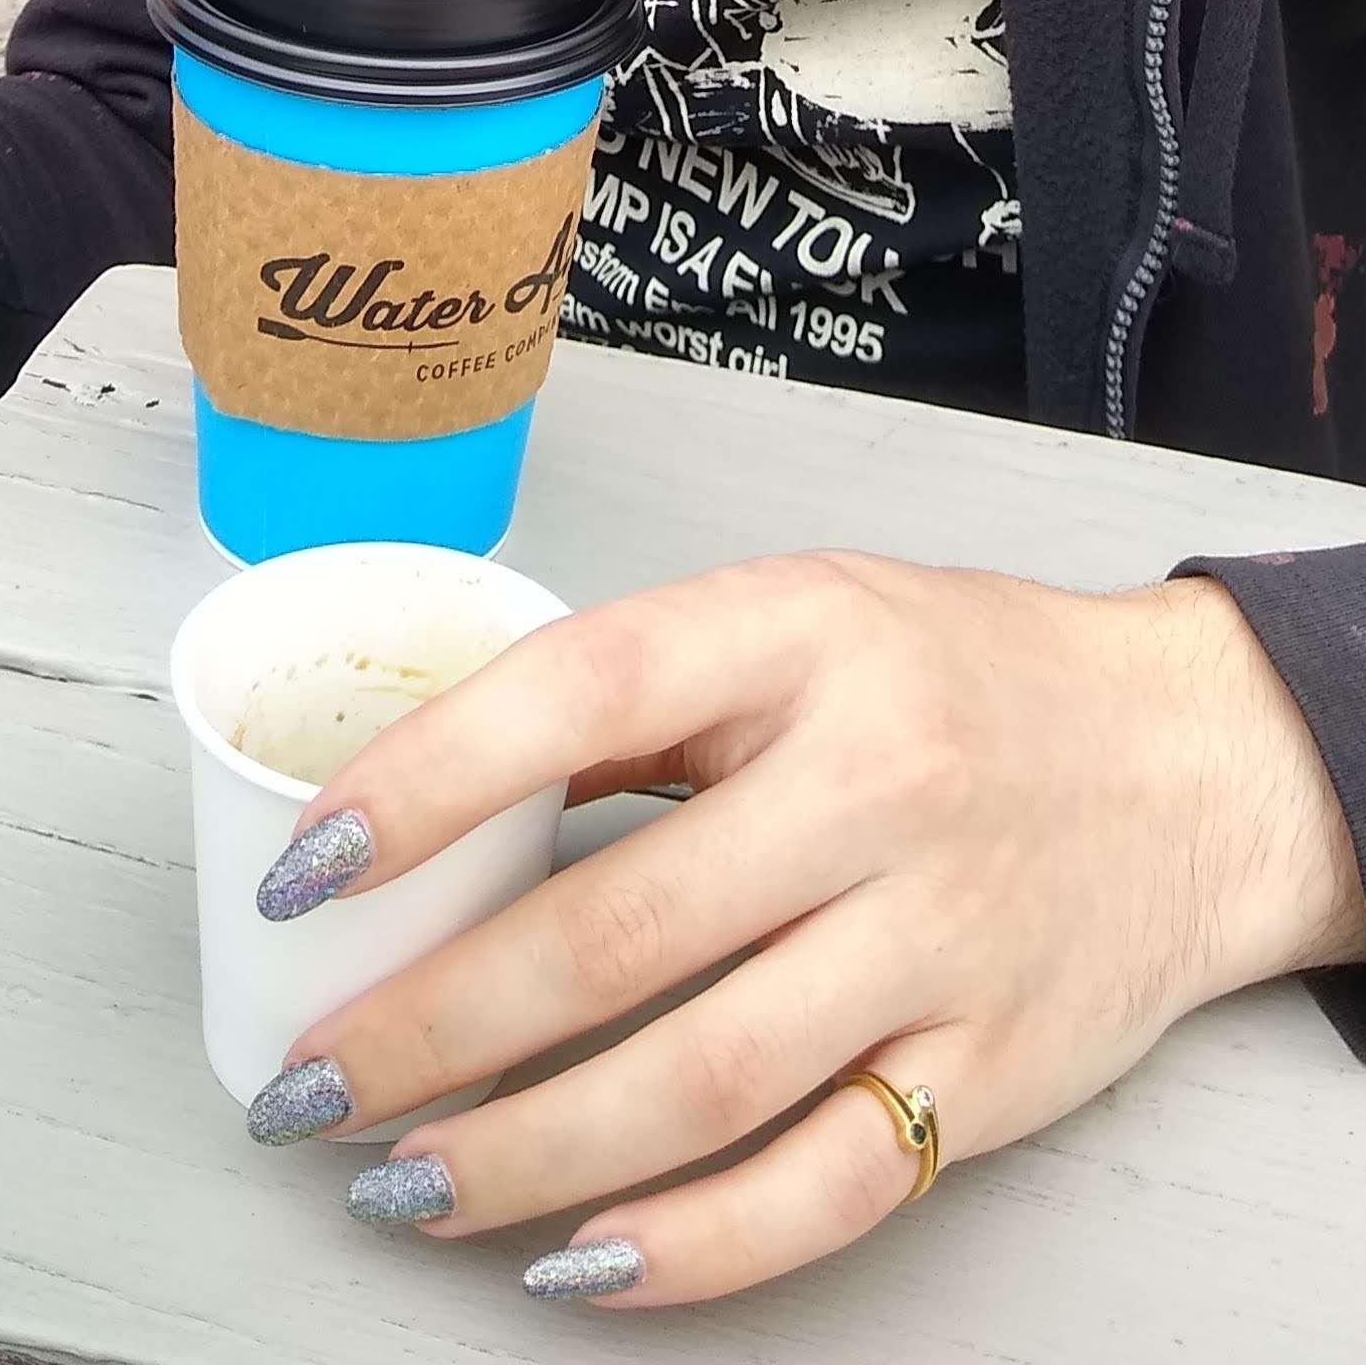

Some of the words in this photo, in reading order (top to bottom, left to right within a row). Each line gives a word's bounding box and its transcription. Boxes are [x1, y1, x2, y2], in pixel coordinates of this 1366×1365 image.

[582, 168, 650, 235] MP
[638, 137, 780, 231] NEW
[259, 252, 495, 333] Water
[416, 351, 497, 382] COFFEE
[505, 314, 557, 363] COMP
[559, 293, 611, 334] am
[615, 320, 724, 368] worst
[790, 300, 885, 363] 1995
